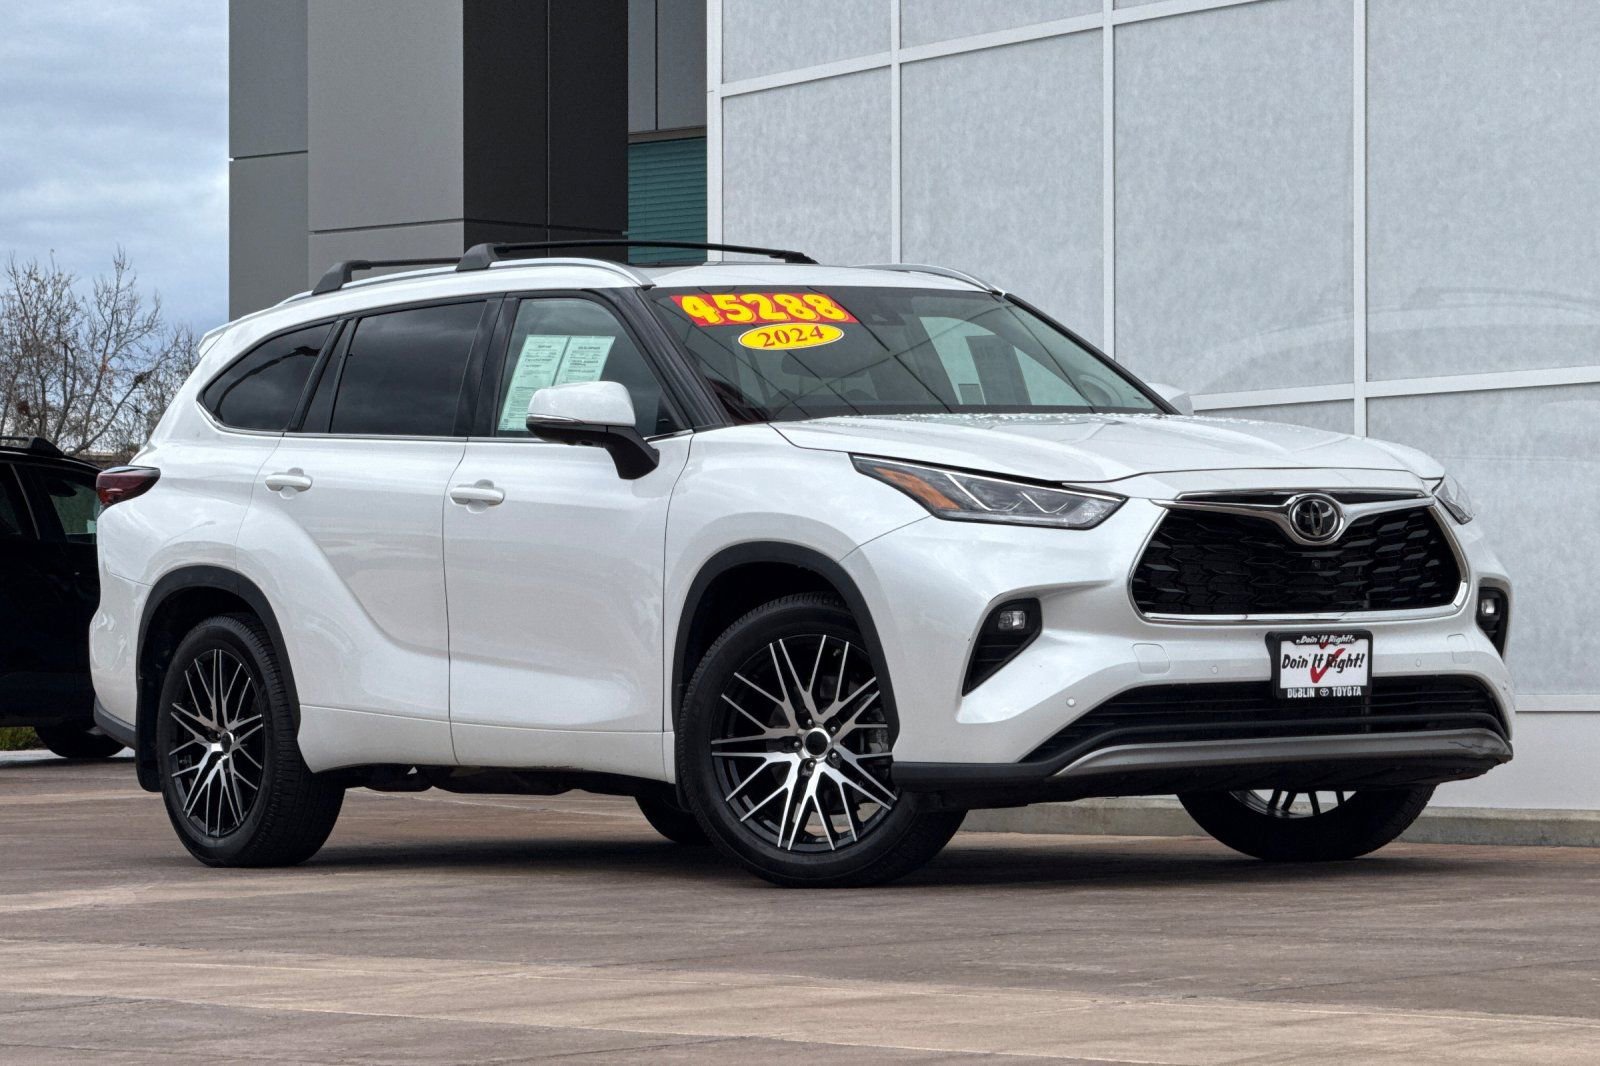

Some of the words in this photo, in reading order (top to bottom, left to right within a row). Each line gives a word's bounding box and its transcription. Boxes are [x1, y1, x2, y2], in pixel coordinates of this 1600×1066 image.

[682, 293, 849, 324] 45288
[758, 325, 825, 347] 2024
[1282, 653, 1311, 669] Doin'
[1312, 654, 1324, 668] It
[1326, 653, 1365, 673] Right!
[1287, 688, 1315, 698] DUBLIN
[1332, 686, 1361, 696] TOYOTA
